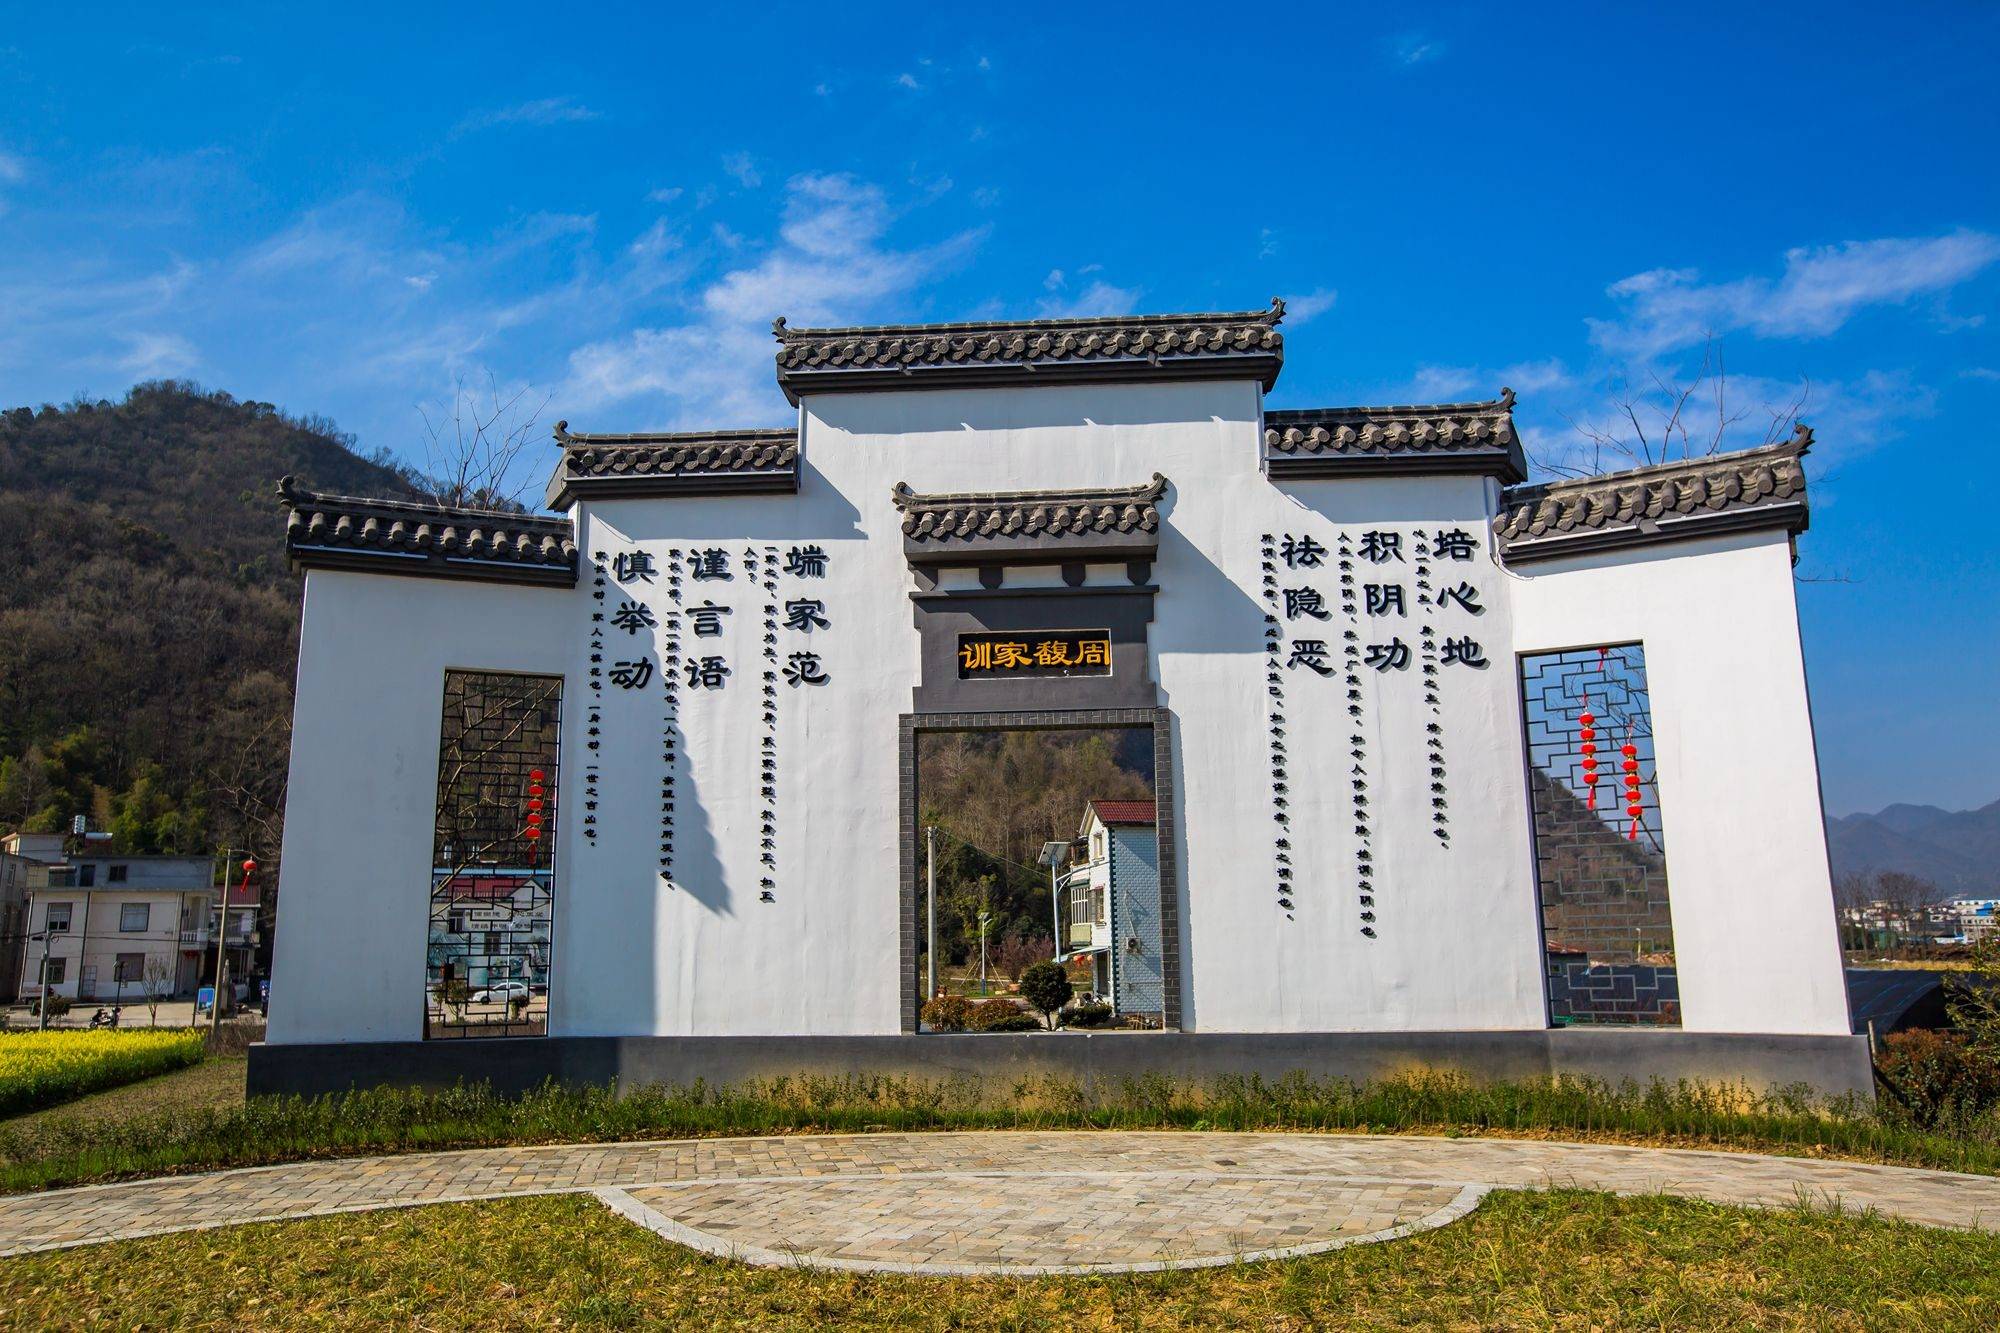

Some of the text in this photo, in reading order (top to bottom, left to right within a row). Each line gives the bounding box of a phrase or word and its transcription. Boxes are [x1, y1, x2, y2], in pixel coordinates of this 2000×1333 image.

[609, 550, 655, 689] 慎举动
[683, 548, 731, 688] 谨言语
[782, 545, 829, 686] 端家范
[959, 640, 1110, 669] 周馥家训
[1280, 532, 1337, 676] 祛隐恶
[1358, 531, 1412, 672] 积阴功
[1433, 529, 1488, 671] 培心地
